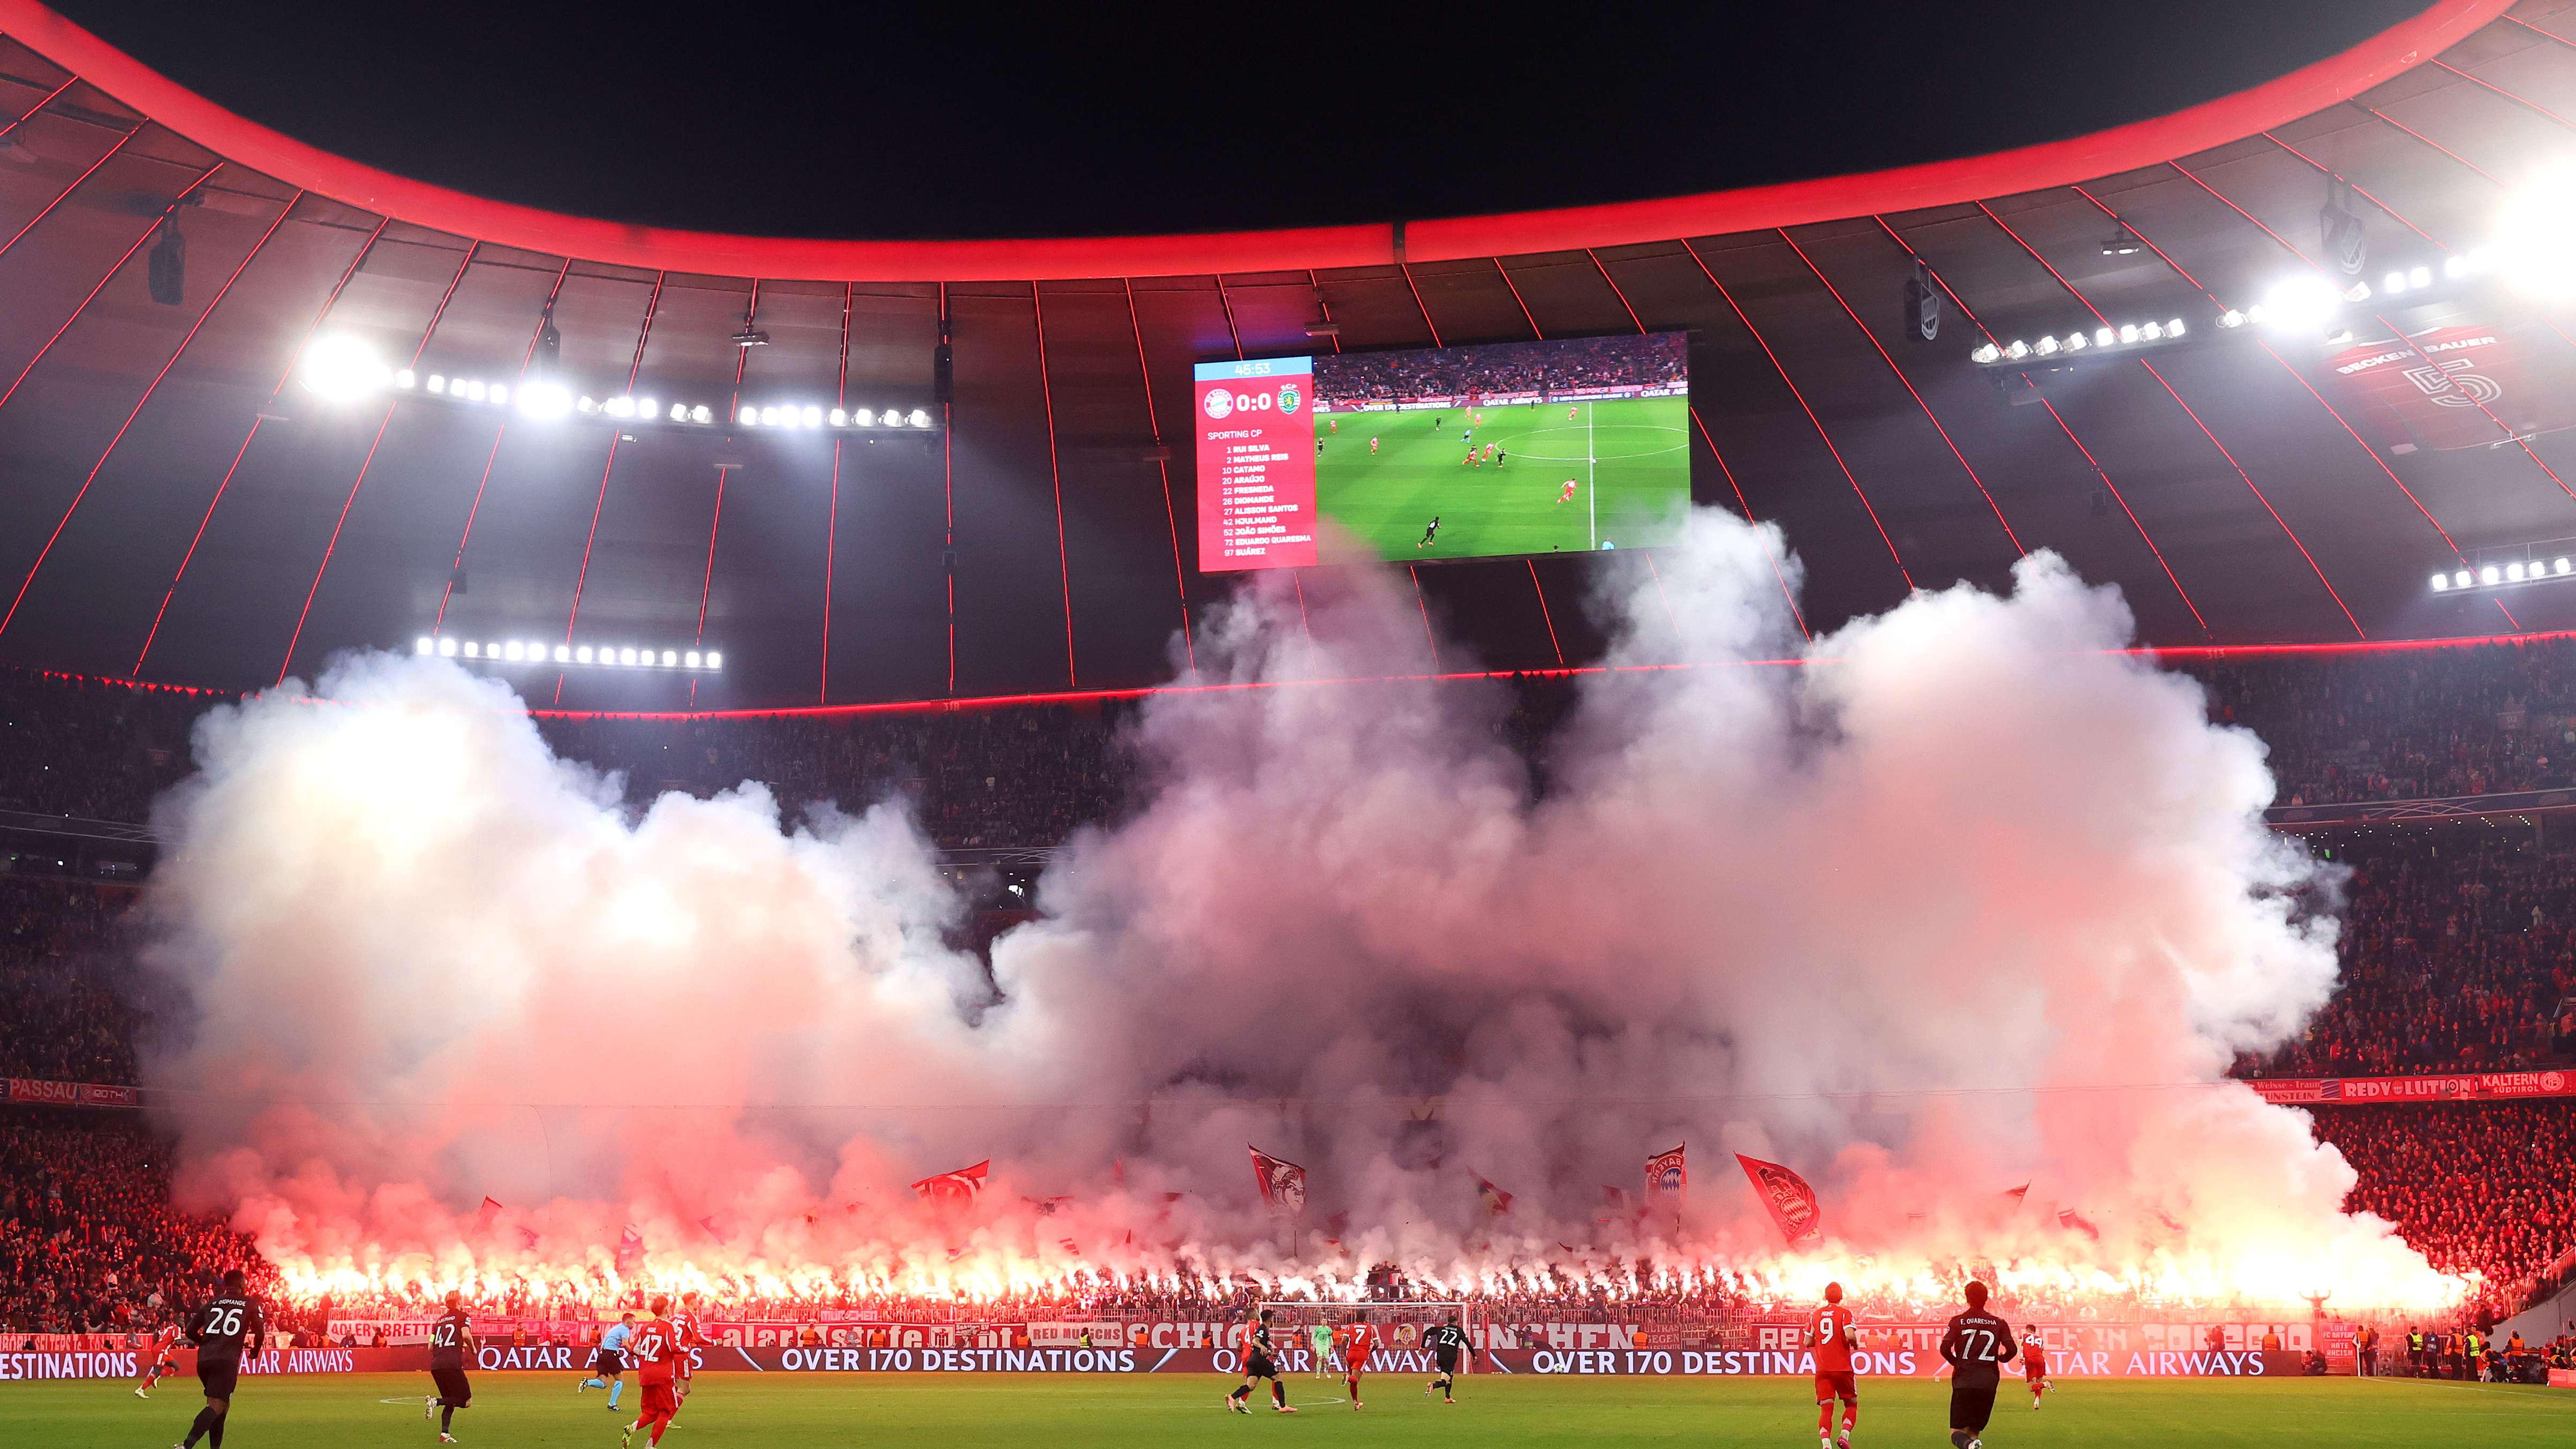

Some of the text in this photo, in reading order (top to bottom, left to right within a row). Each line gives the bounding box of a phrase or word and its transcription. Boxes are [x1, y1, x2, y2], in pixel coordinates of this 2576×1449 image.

[2336, 336, 2497, 374] BECKEN BAUER
[1235, 363, 1271, 375] 45:53
[2401, 358, 2502, 407] 5
[1641, 389, 1671, 397] QATAR
[1236, 393, 1271, 411] 0:0
[1207, 429, 1263, 440] SPORTING CP
[1233, 454, 1270, 463] MATHEUS
[1233, 465, 1265, 473] CATAMO
[1234, 474, 1265, 484] ARAÚJO
[1234, 485, 1274, 494] FRESNEDA
[1234, 495, 1274, 504] DIOMANDE
[1234, 506, 1266, 515] ALISSON
[1268, 504, 1298, 512] SANTOS
[1235, 516, 1277, 525] HJULMAND
[1235, 526, 1256, 535] JOÃO
[1257, 525, 1286, 534] SIMÕES
[1235, 537, 1270, 546] EDUARDO
[1271, 535, 1311, 544] QUARESMA
[1235, 547, 1265, 556] SUÁREZ
[2482, 1073, 2539, 1086] KALTERN
[9, 1079, 78, 1099] PASSAU
[94, 1089, 123, 1098] ROTH
[2494, 1085, 2539, 1093] SÜDTIROL
[2265, 1092, 2315, 1101] UNSTEIN
[218, 1298, 246, 1307] DIOMANDE
[206, 1307, 243, 1336] 26
[1644, 1324, 1680, 1333] ULTRAS
[383, 1323, 431, 1337] BRETT
[435, 1324, 456, 1348] 42
[1033, 1328, 1121, 1340] RED MUiCHS
[1244, 1328, 1251, 1344] 4
[1355, 1329, 1365, 1344] 7
[1819, 1318, 1833, 1344] 9
[1439, 1329, 1457, 1346] 22
[1646, 1334, 1680, 1344] GEGEN
[1759, 1328, 1800, 1350] RE
[2025, 1334, 2044, 1348] 44
[640, 1334, 662, 1362] 42
[1961, 1329, 1996, 1361] 72
[238, 1350, 353, 1375] AAR AIRWAYS
[478, 1347, 572, 1370] QATAR
[782, 1349, 1135, 1372] OVER 170 DESTINATIONS
[1213, 1349, 1441, 1373] QAR AWAY
[1533, 1350, 1916, 1375] OVER 170 DESTINAONS
[2126, 1352, 2264, 1376] AIRWAYS
[0, 1352, 137, 1380] ESTINATIONS
